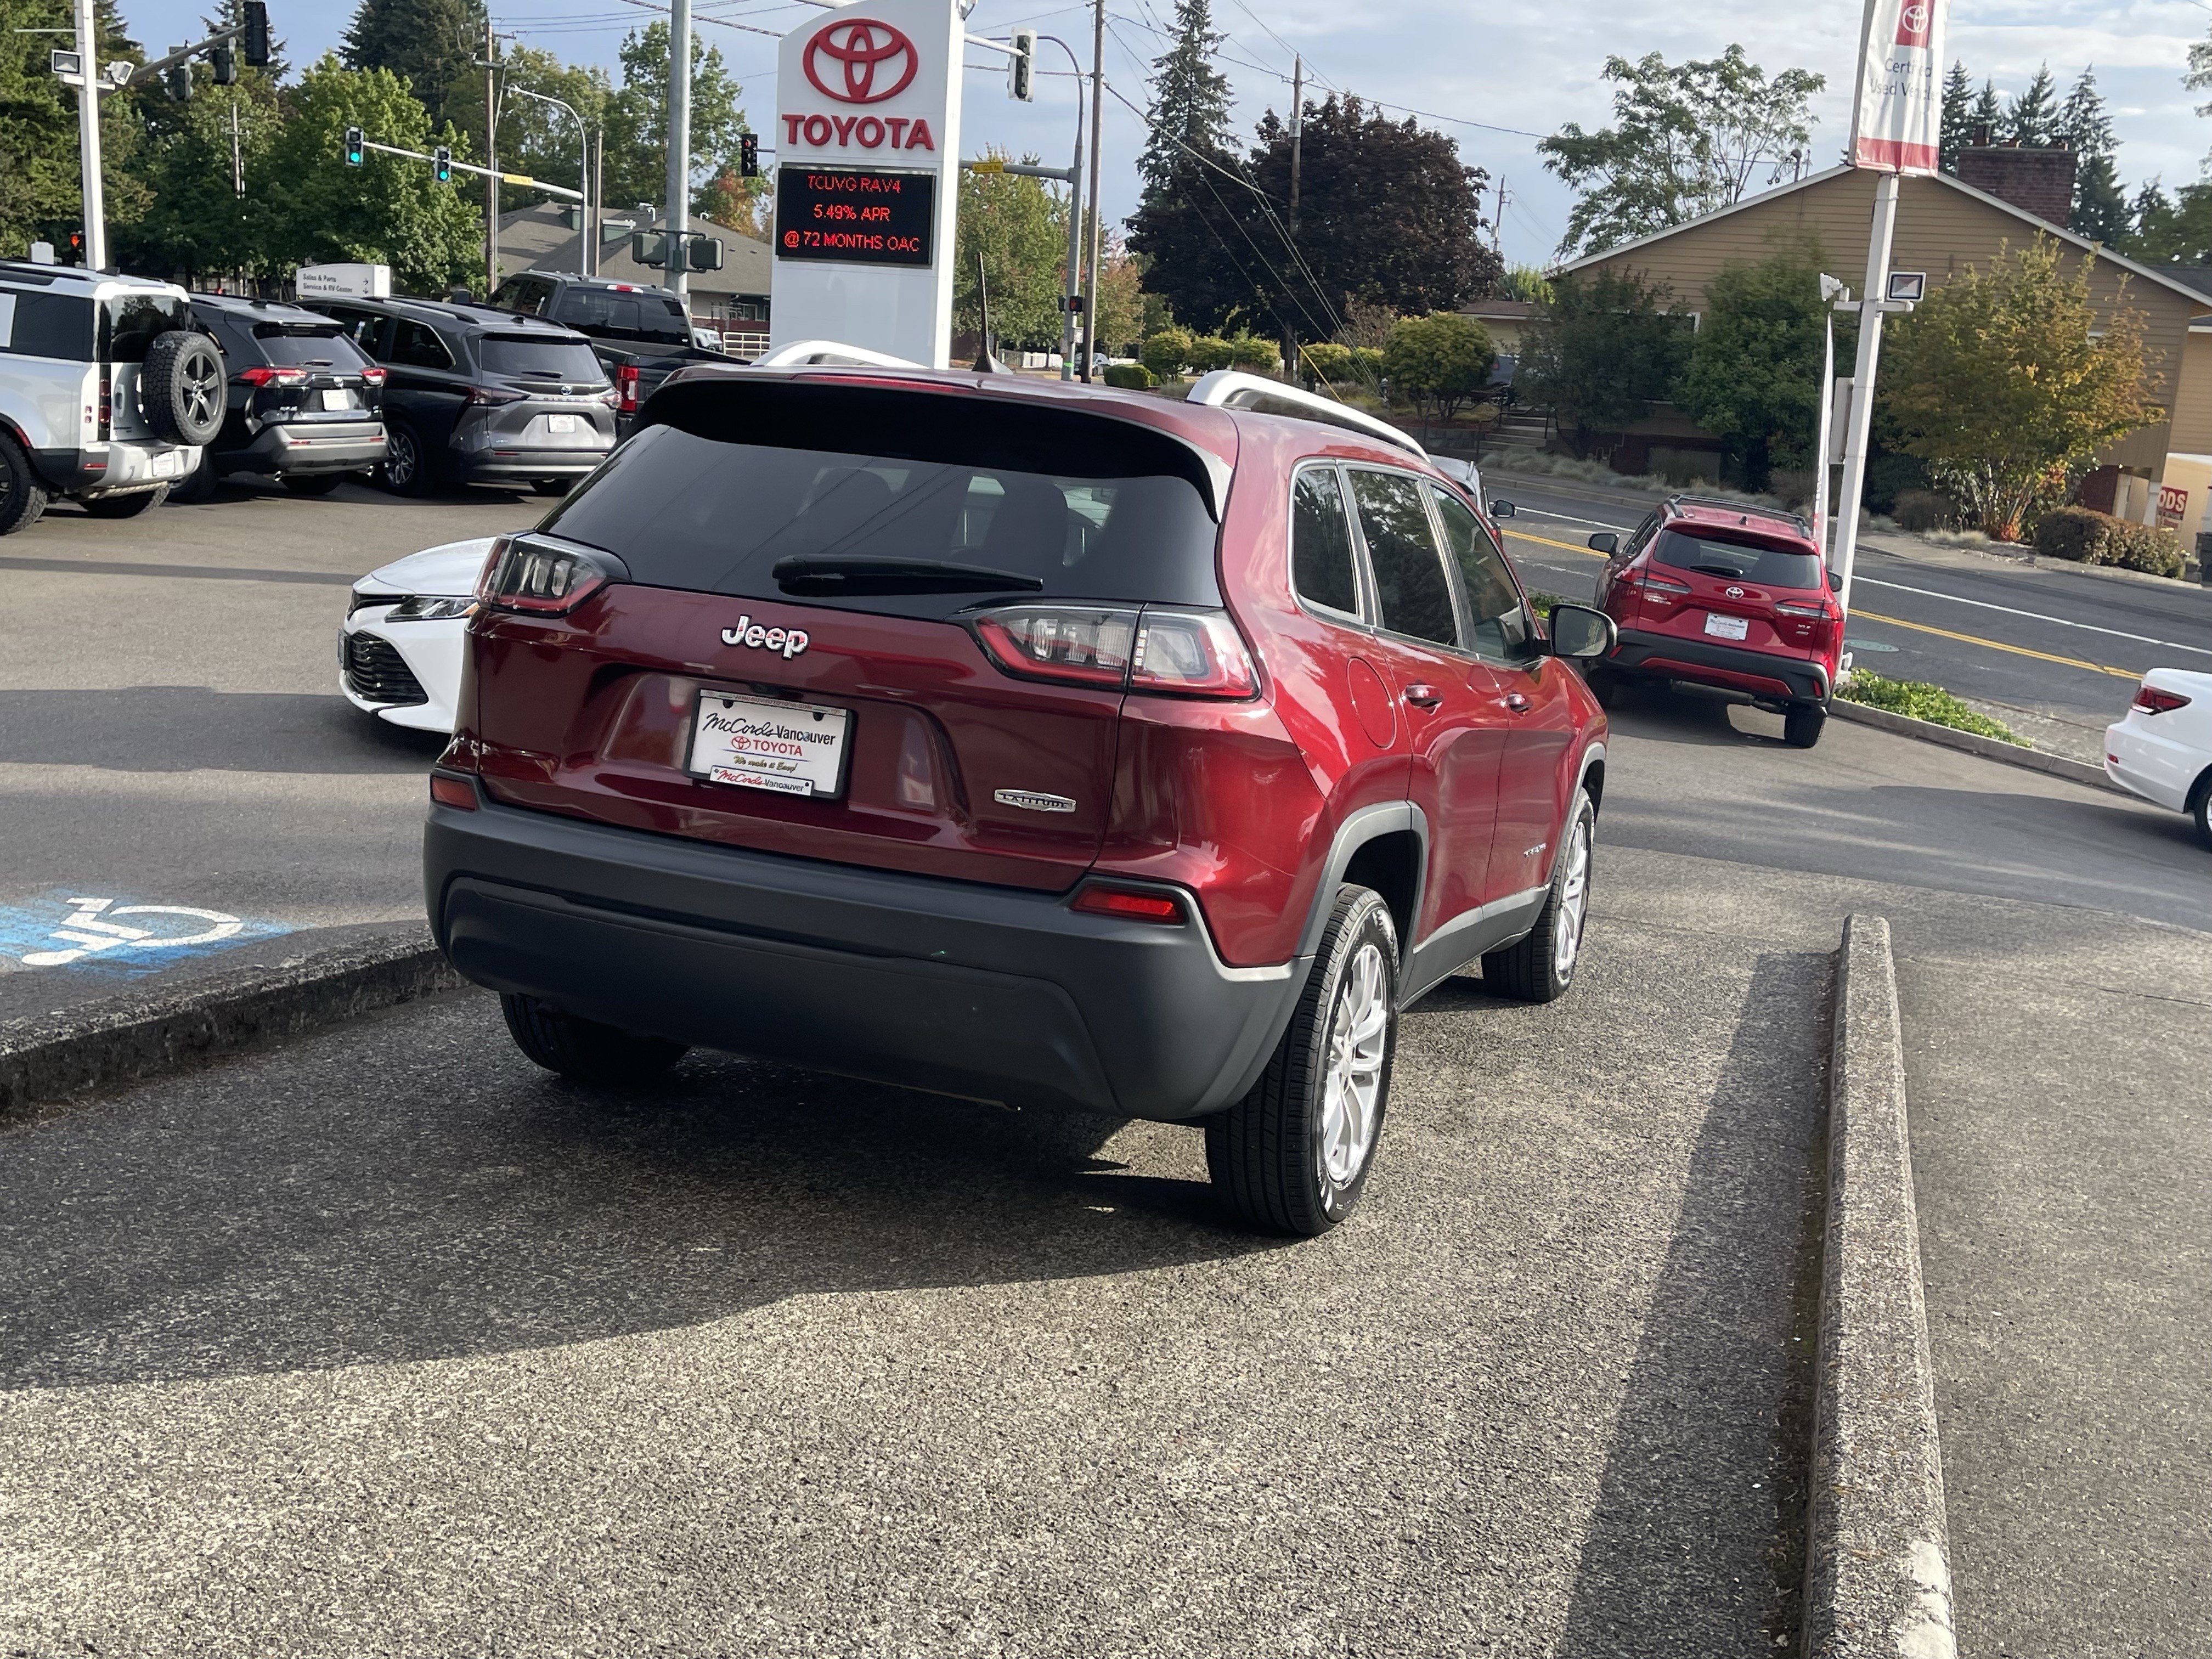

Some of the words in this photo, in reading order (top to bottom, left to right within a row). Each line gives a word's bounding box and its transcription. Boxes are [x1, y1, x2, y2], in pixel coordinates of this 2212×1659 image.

[1884, 57, 1933, 78] Certied
[1870, 78, 1898, 96] Used
[781, 114, 935, 151] TOYOTA
[860, 177, 901, 194] RAV4
[813, 203, 857, 221] 5.49%
[860, 206, 891, 223] APR
[783, 230, 800, 249] @
[803, 231, 820, 247] 72
[823, 232, 884, 250] MONTHS
[887, 236, 920, 253] OAC
[721, 614, 809, 659] Jeep
[702, 712, 777, 737] McCords
[776, 725, 836, 746] Vancouver
[753, 740, 803, 757] TOYOTA
[733, 755, 746, 765] We
[747, 759, 767, 768] make
[776, 761, 798, 774] Easy!
[716, 770, 765, 786] McCords
[765, 778, 805, 792] Vancouver
[1001, 793, 1069, 808] LATITUDE
